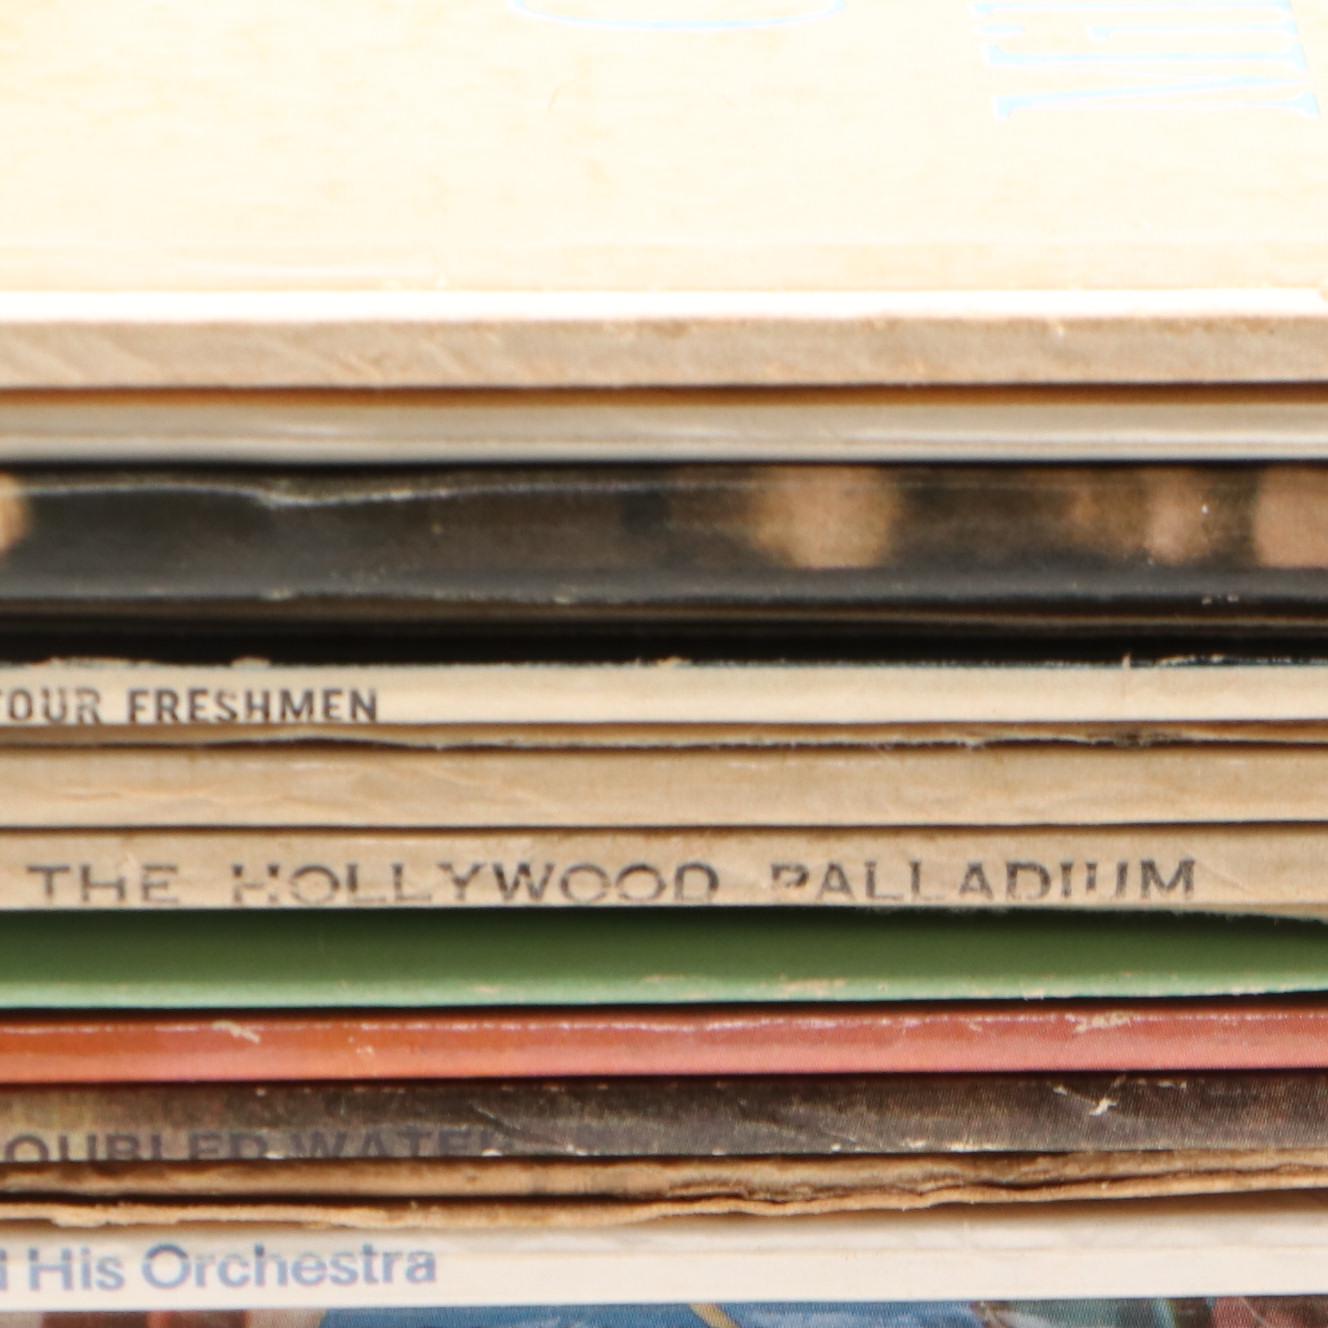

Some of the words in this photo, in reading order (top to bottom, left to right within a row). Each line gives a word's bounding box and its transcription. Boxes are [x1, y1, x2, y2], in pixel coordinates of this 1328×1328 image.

[0, 688, 102, 724] OUR
[126, 688, 378, 723] FRESHMEN
[26, 864, 180, 904] THE
[231, 862, 720, 904] HOLLYWOOD
[770, 858, 1197, 901] PALLADIUM
[28, 1246, 126, 1292] His
[141, 1242, 438, 1289] Orchestra
